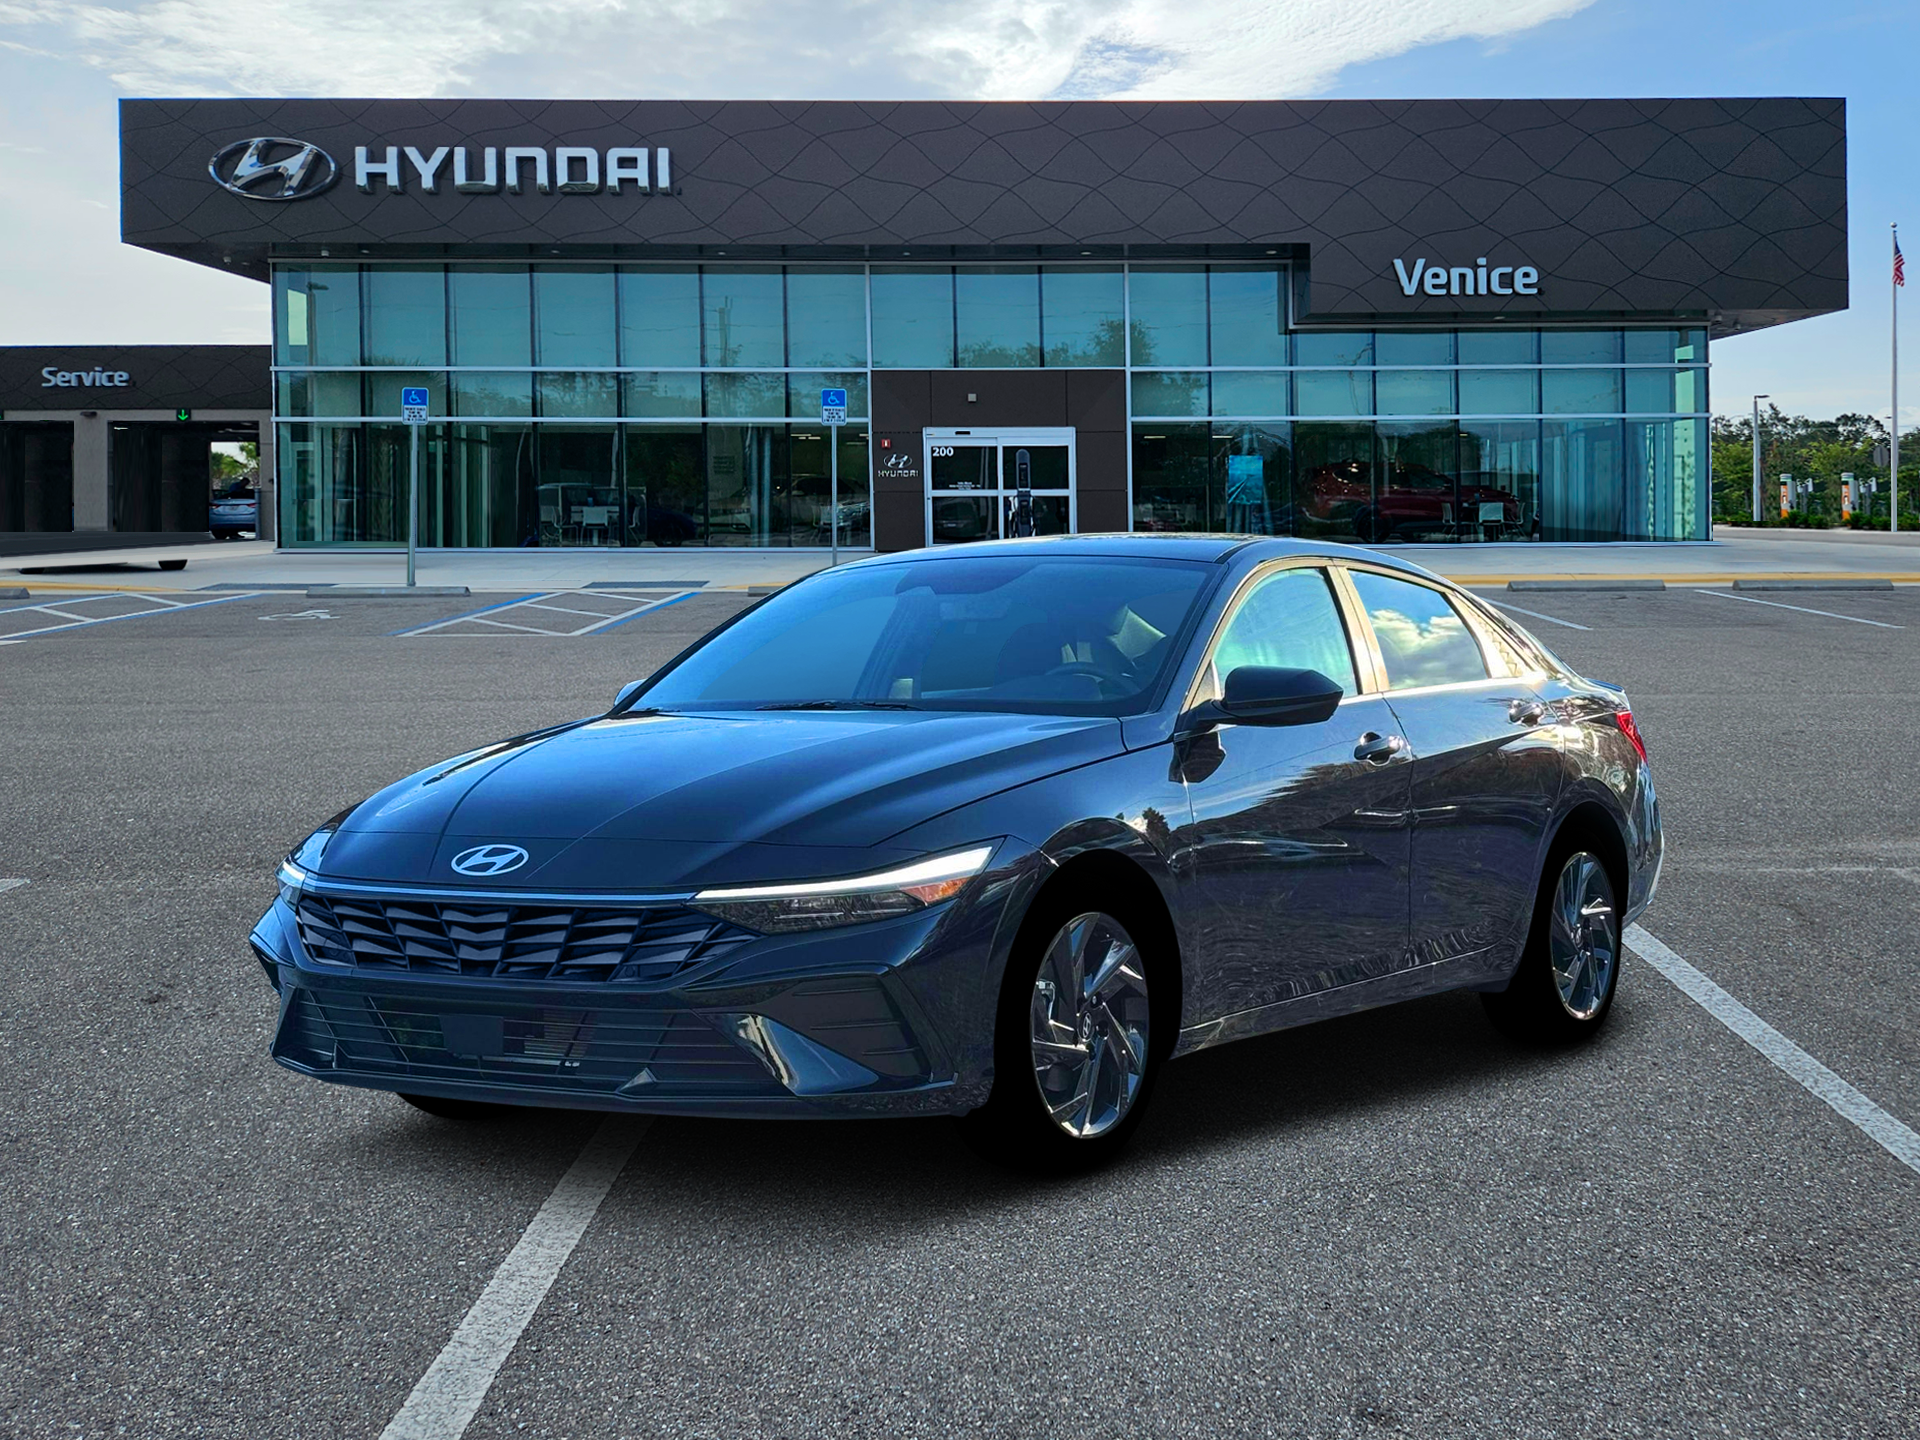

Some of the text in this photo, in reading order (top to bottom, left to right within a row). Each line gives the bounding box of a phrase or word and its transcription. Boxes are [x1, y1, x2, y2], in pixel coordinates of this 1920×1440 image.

[355, 146, 671, 193] HYUNDAI
[1392, 257, 1539, 296] Venice
[41, 366, 130, 388] Service
[932, 446, 954, 457] 200
[877, 470, 920, 478] HYUNDAI
